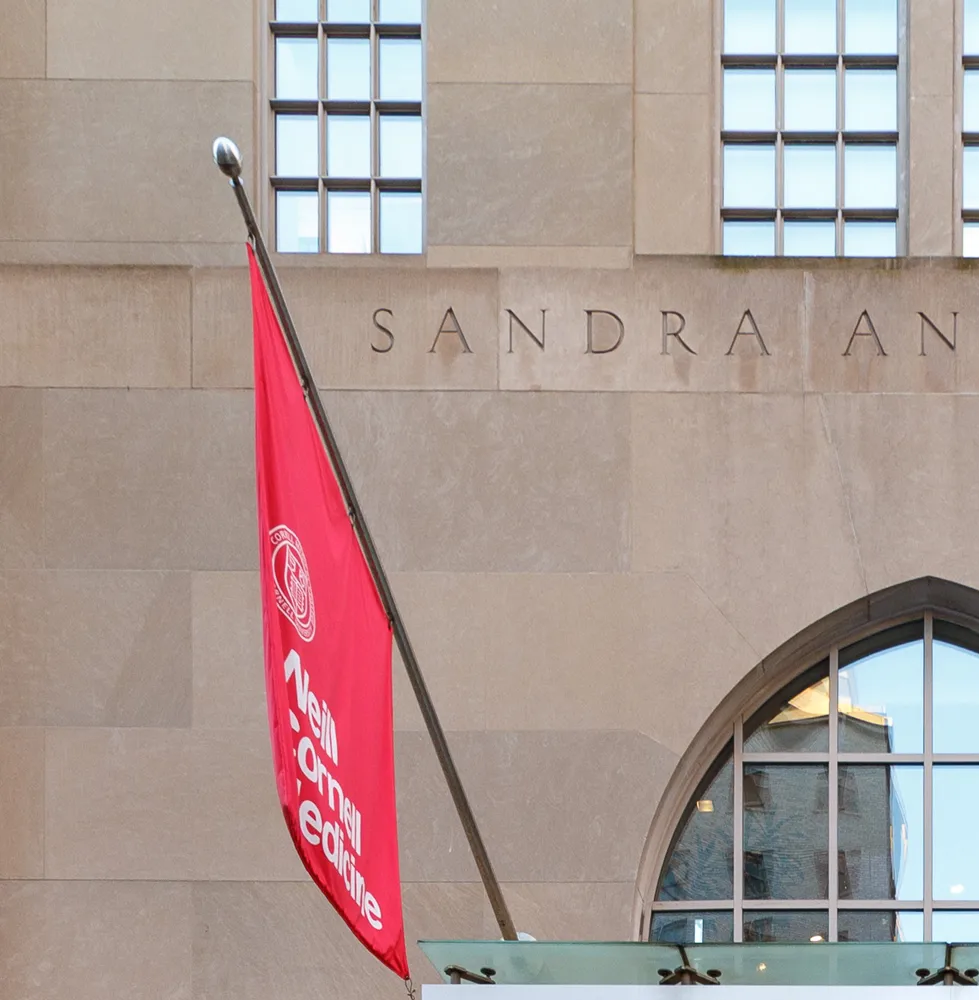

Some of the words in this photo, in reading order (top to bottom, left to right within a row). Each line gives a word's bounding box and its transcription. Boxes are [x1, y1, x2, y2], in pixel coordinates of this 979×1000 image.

[370, 306, 772, 357] SANDRA
[289, 709, 362, 857] ornell
[297, 778, 383, 931] edicine
